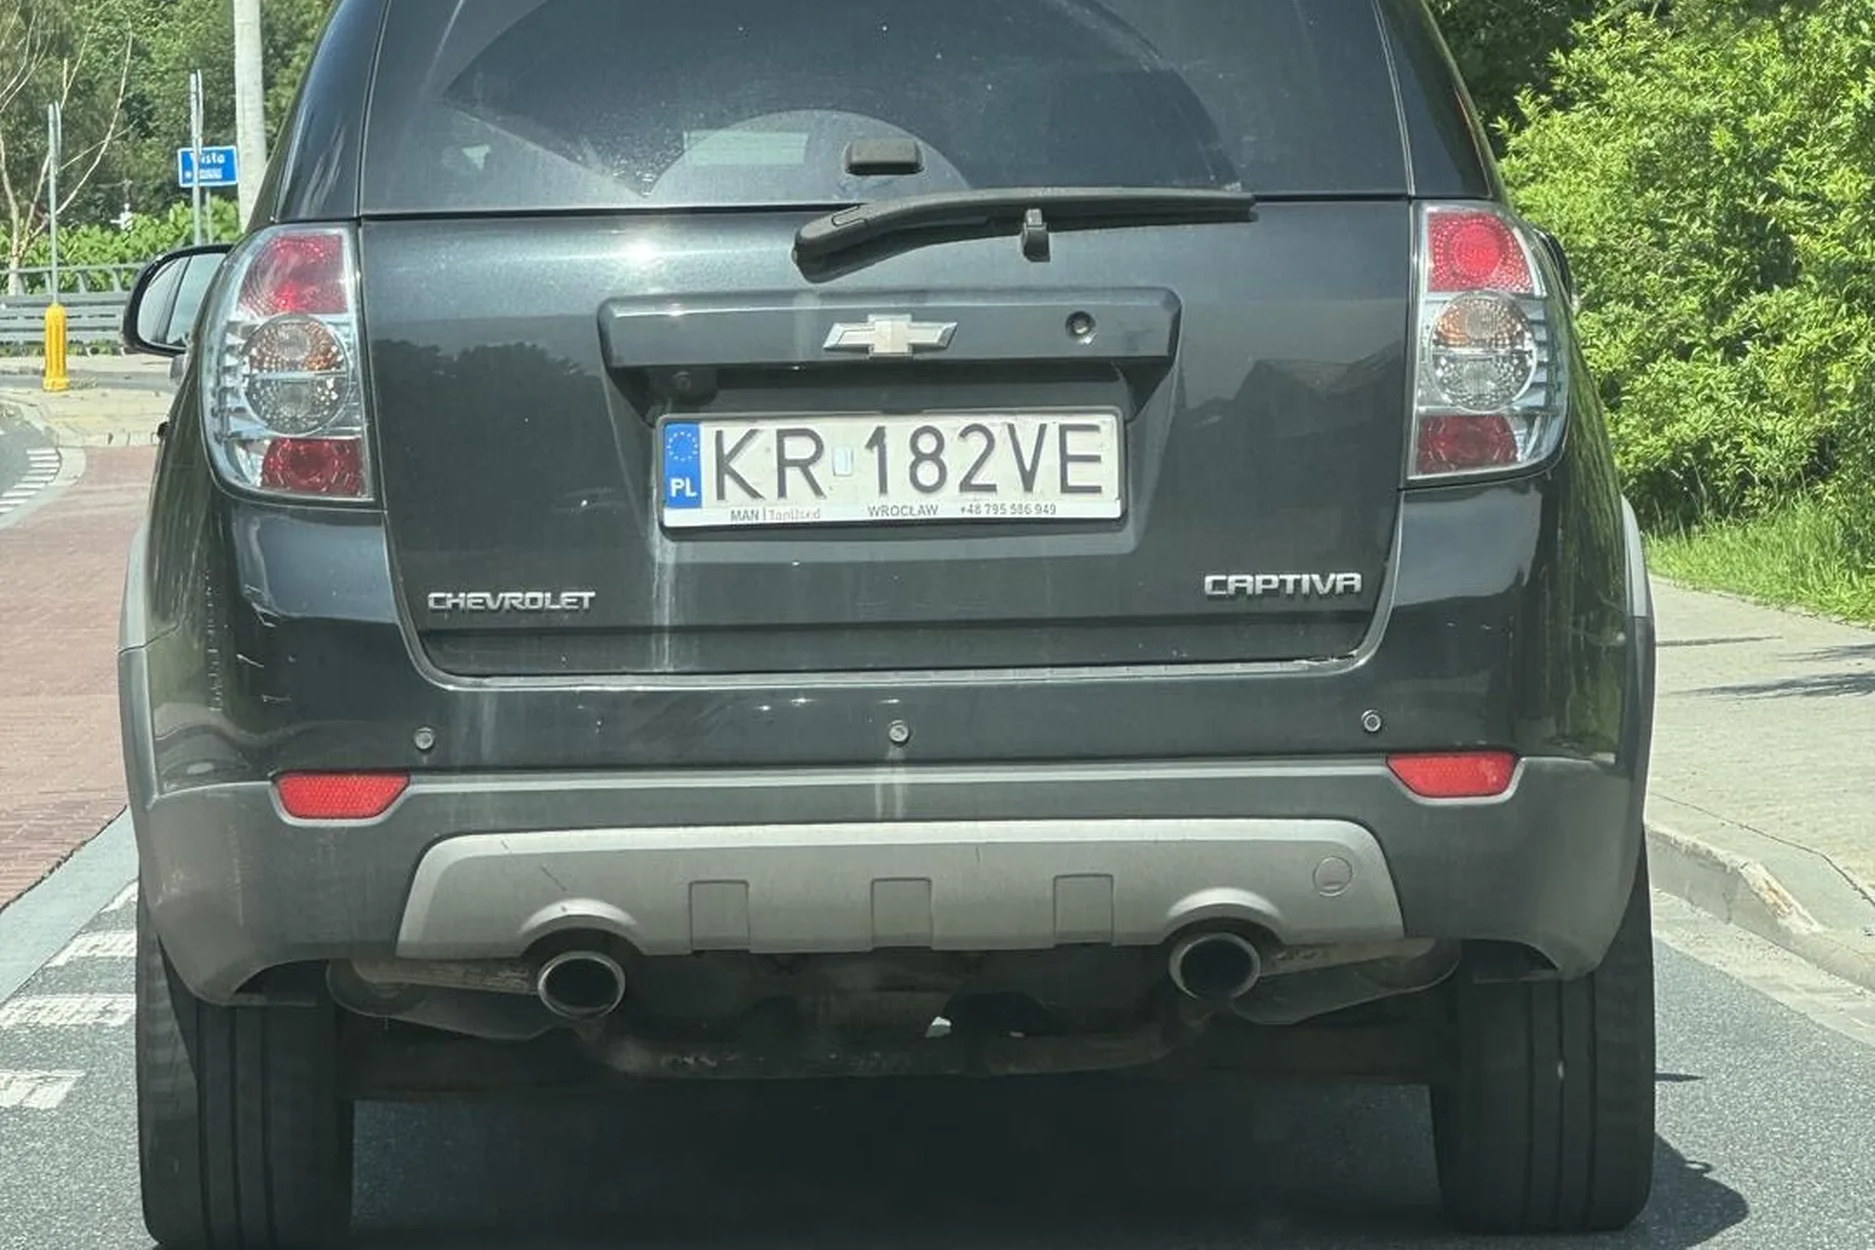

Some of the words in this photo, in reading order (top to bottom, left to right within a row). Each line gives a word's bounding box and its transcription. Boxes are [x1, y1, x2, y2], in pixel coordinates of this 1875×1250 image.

[714, 427, 827, 500] KR
[865, 423, 1103, 496] 182VE
[670, 478, 698, 497] PL
[730, 509, 759, 521] MAN
[867, 504, 939, 517] WROCŁAW
[1204, 572, 1362, 596] CAPTIVA
[428, 591, 596, 611] CHEVROLET
